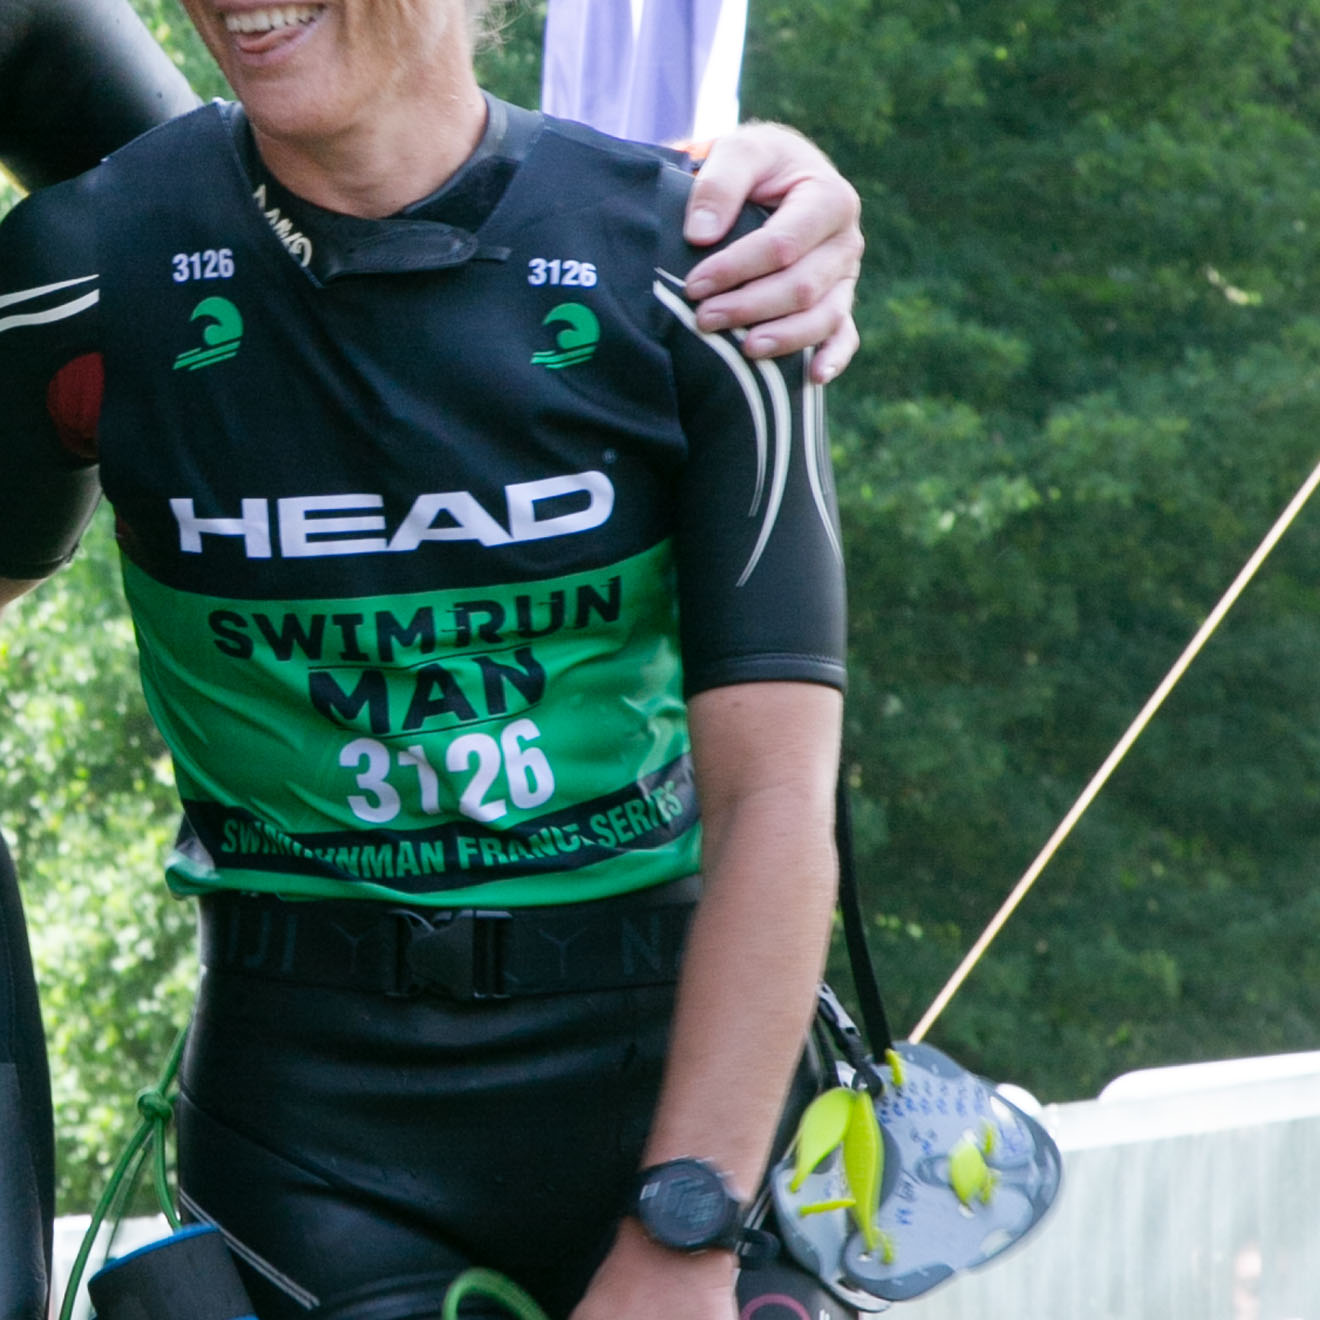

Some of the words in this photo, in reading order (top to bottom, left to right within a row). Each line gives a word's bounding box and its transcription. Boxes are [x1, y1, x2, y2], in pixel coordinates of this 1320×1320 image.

[172, 249, 235, 282] 3126
[528, 258, 597, 287] 3126
[170, 470, 616, 559] HEAD
[209, 576, 623, 663] SWIMRUN
[311, 647, 547, 736] MAN
[338, 719, 557, 824] 3126
